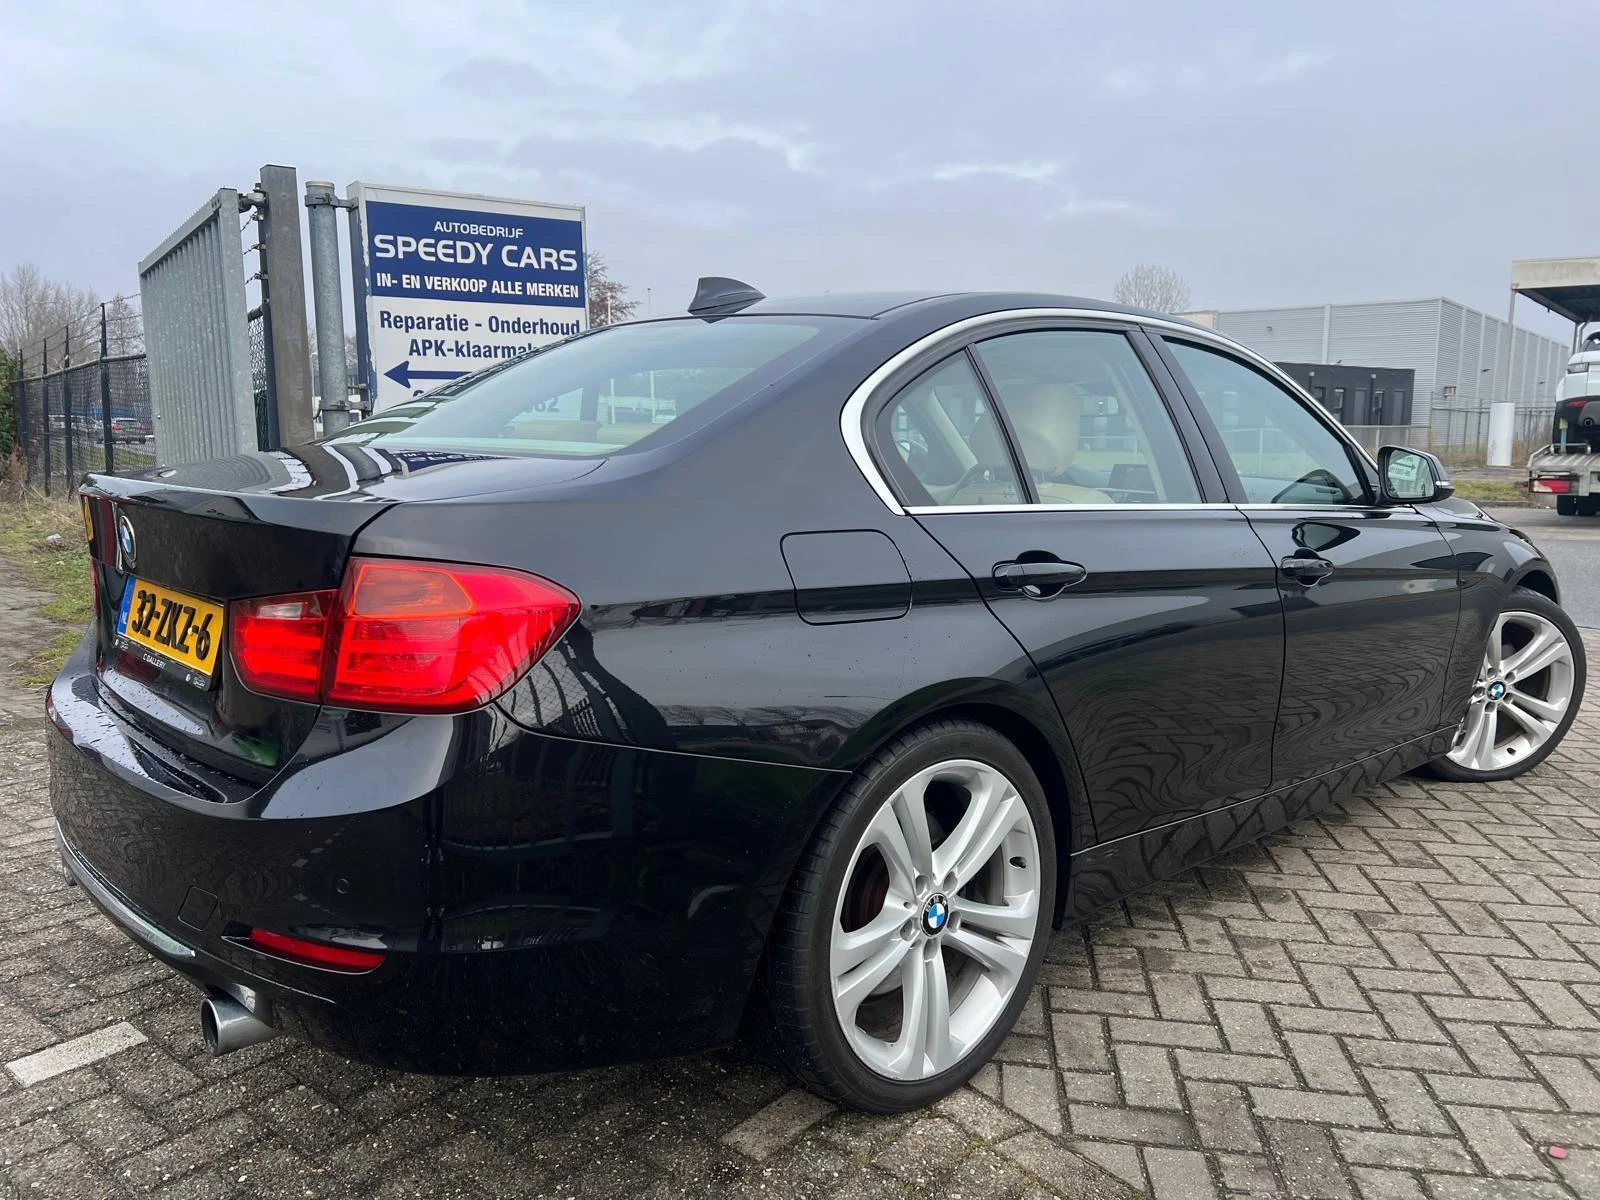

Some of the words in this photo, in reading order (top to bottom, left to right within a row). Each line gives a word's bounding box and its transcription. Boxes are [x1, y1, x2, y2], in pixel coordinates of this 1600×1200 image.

[433, 221, 524, 239] AUTOBEDRIJF
[373, 234, 494, 265] SPEEDY
[501, 245, 578, 271] CARS
[376, 273, 398, 287] IN-
[402, 274, 421, 289] EN
[424, 276, 487, 293] VERKOOP
[491, 280, 523, 295] ALLE
[526, 282, 579, 298] MERKEN
[379, 310, 469, 334] Reparatie
[488, 315, 580, 336] Onderhoud
